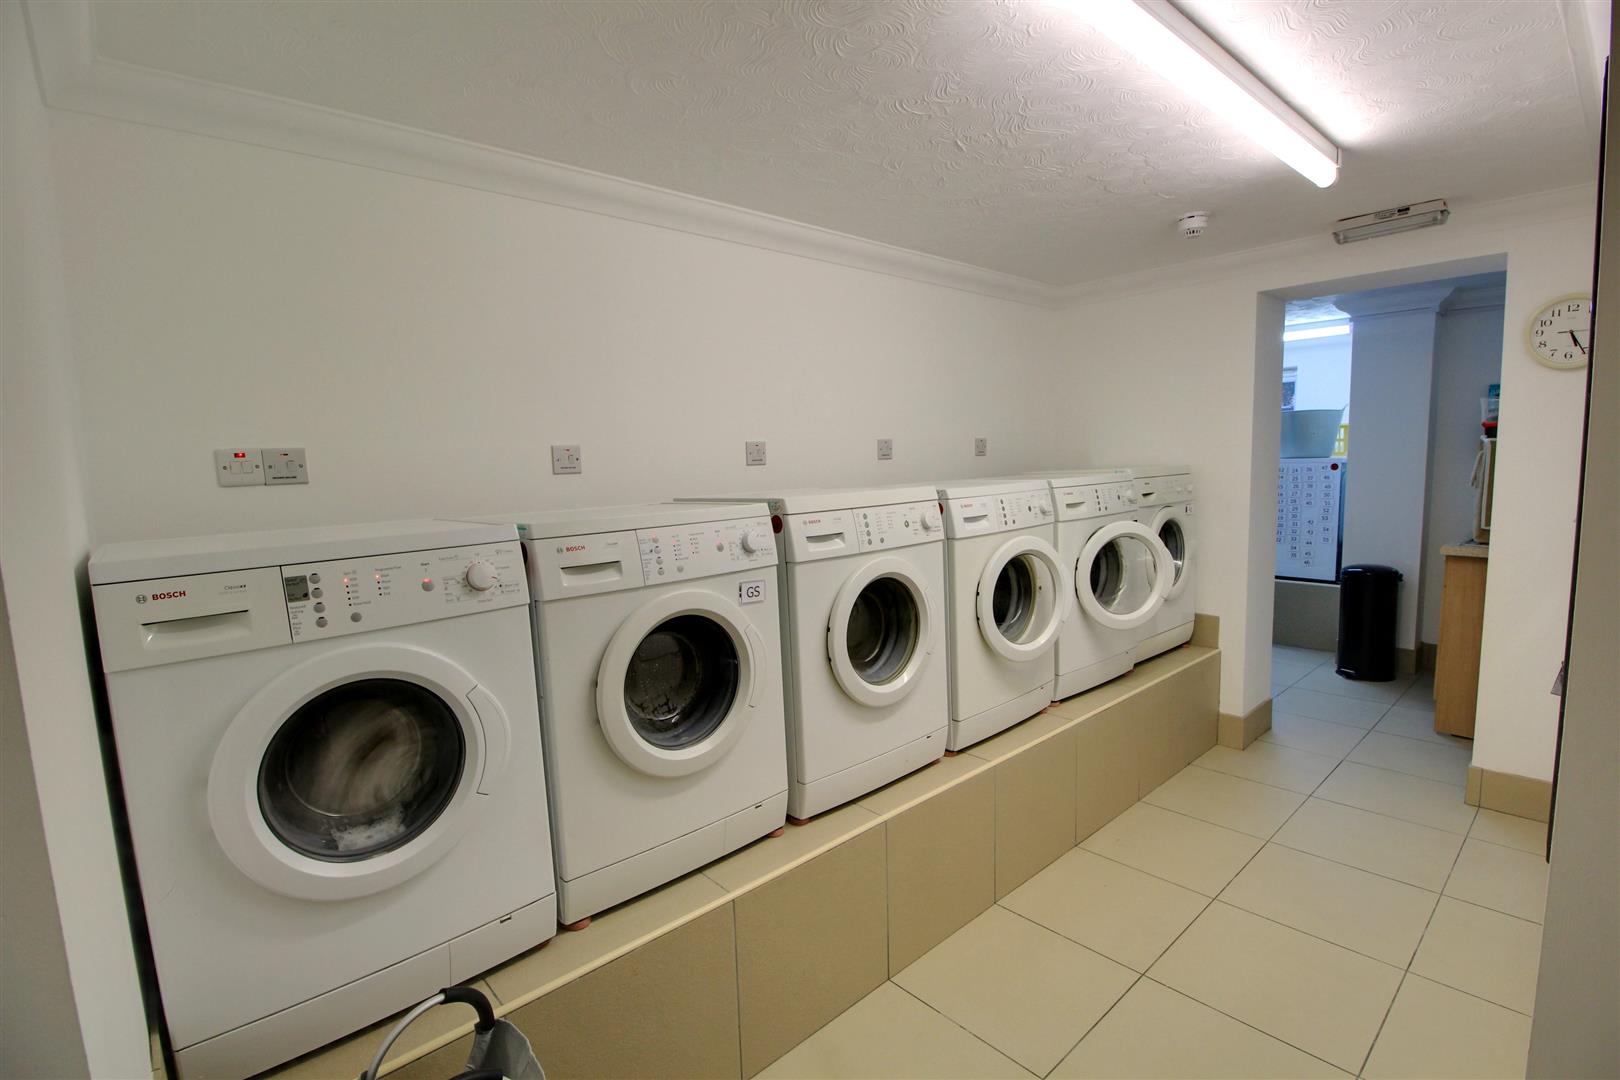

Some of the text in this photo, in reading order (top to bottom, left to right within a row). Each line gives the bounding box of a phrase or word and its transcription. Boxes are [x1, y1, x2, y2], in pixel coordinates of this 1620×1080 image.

[1552, 308, 1560, 317] 11
[1567, 304, 1580, 312] 12
[1564, 351, 1572, 359] 6
[152, 591, 186, 601] BOSCH
[746, 586, 761, 598] GS
